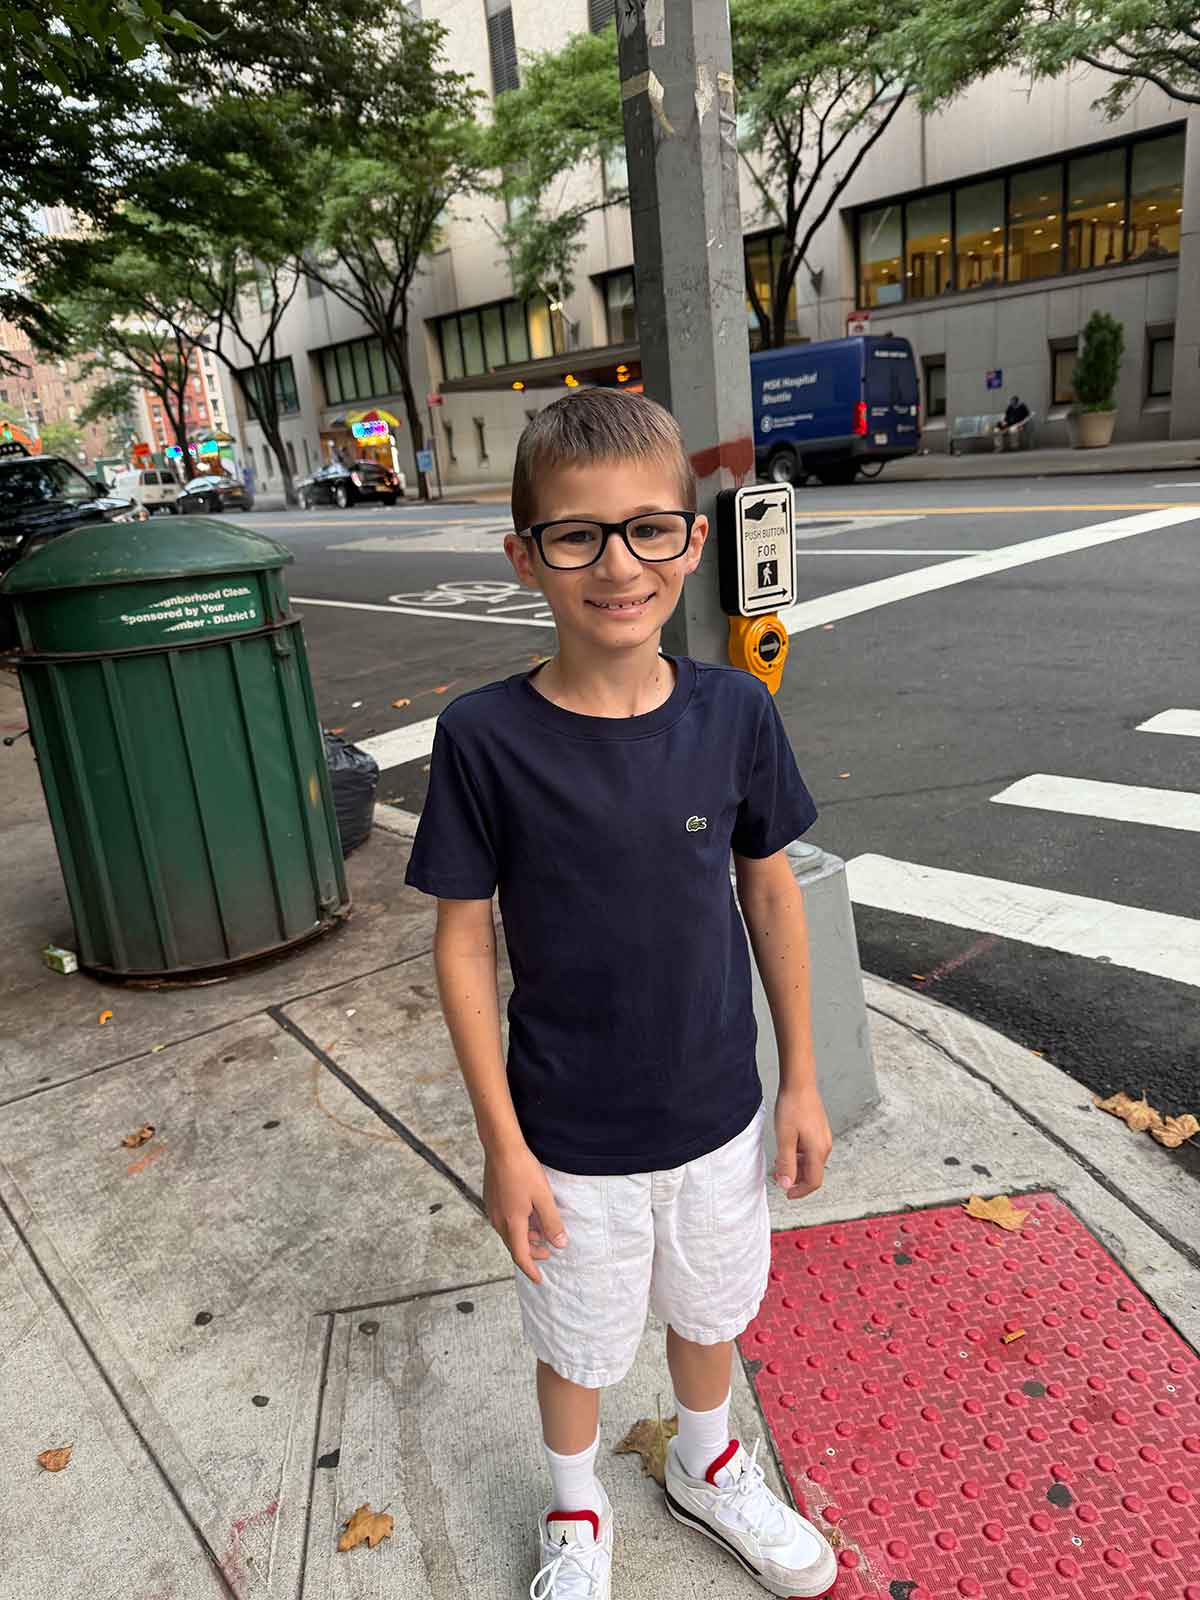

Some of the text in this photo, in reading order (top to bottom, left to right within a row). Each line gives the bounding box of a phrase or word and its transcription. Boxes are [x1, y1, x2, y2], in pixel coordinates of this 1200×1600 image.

[782, 371, 818, 388] Hospital
[762, 392, 791, 405] Shuttle
[744, 527, 785, 541] PUSH BUTTON
[757, 543, 776, 557] FOR
[120, 603, 225, 625] Sponsored by Your
[213, 612, 249, 624] District
